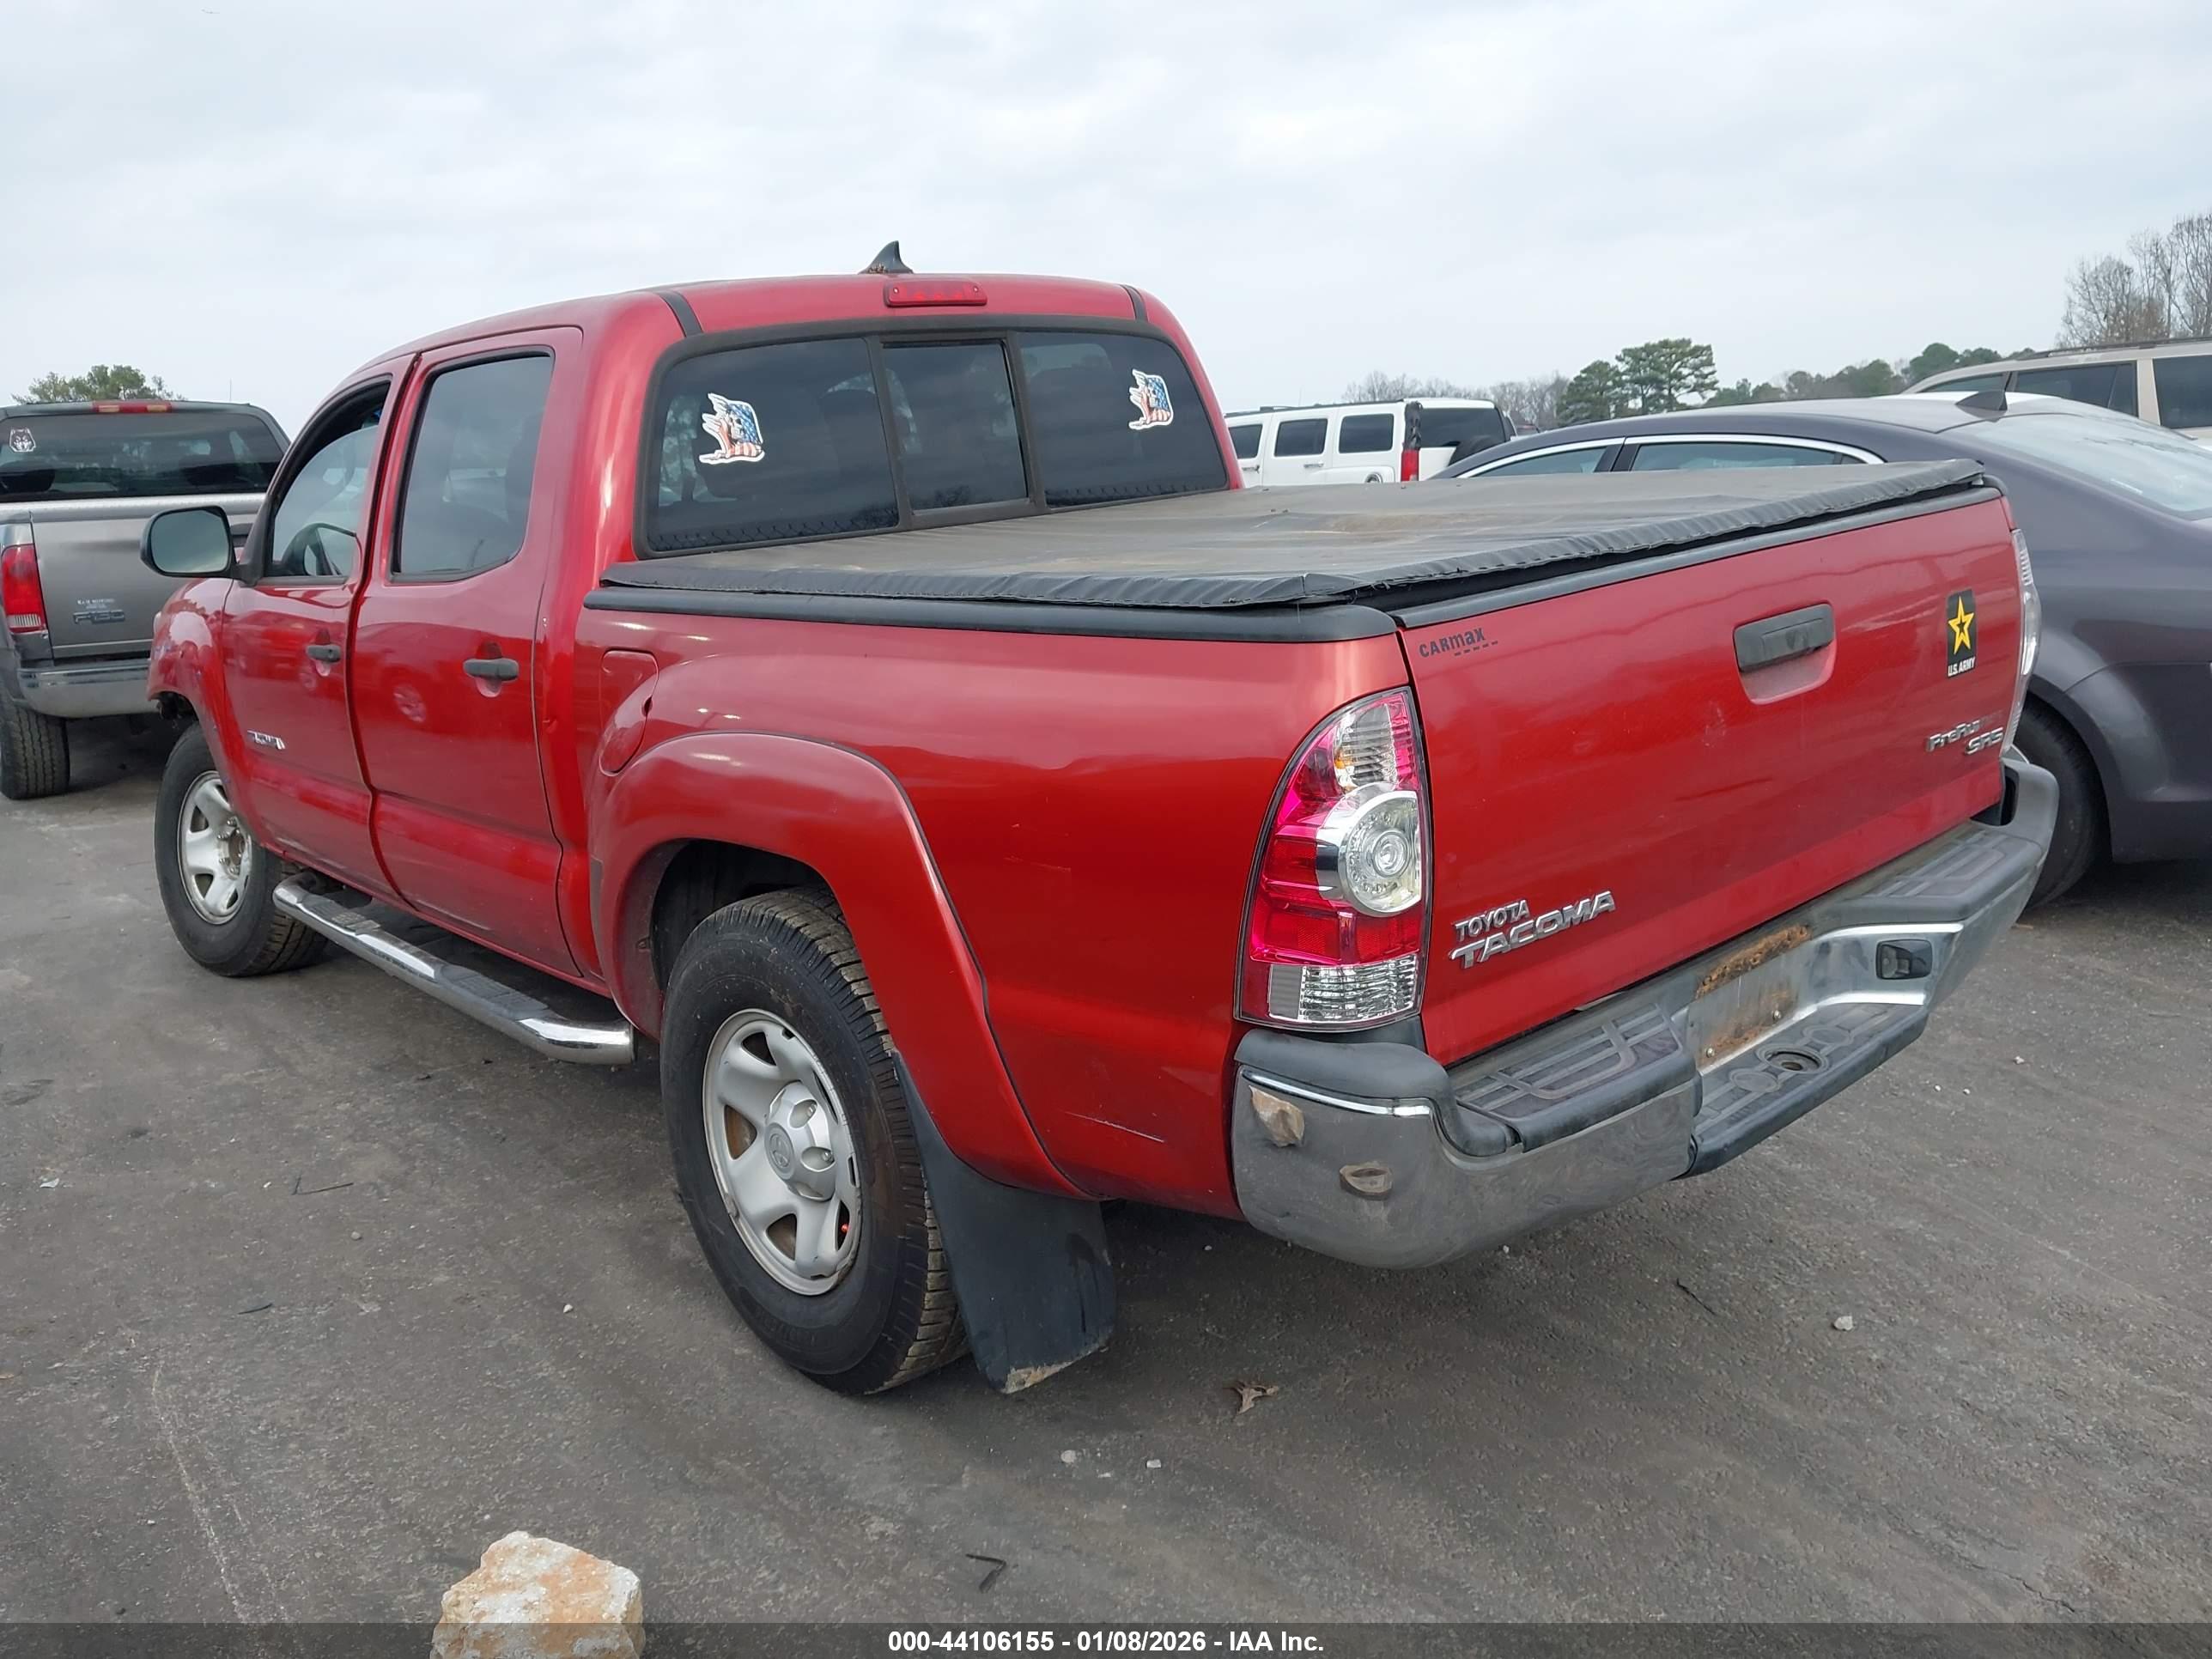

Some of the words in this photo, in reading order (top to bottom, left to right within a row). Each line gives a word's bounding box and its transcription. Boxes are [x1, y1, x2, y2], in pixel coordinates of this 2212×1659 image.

[1959, 656, 1976, 673] ARMY
[1449, 890, 1616, 969] TACOMA
[1453, 899, 1531, 942] TOYOTA
